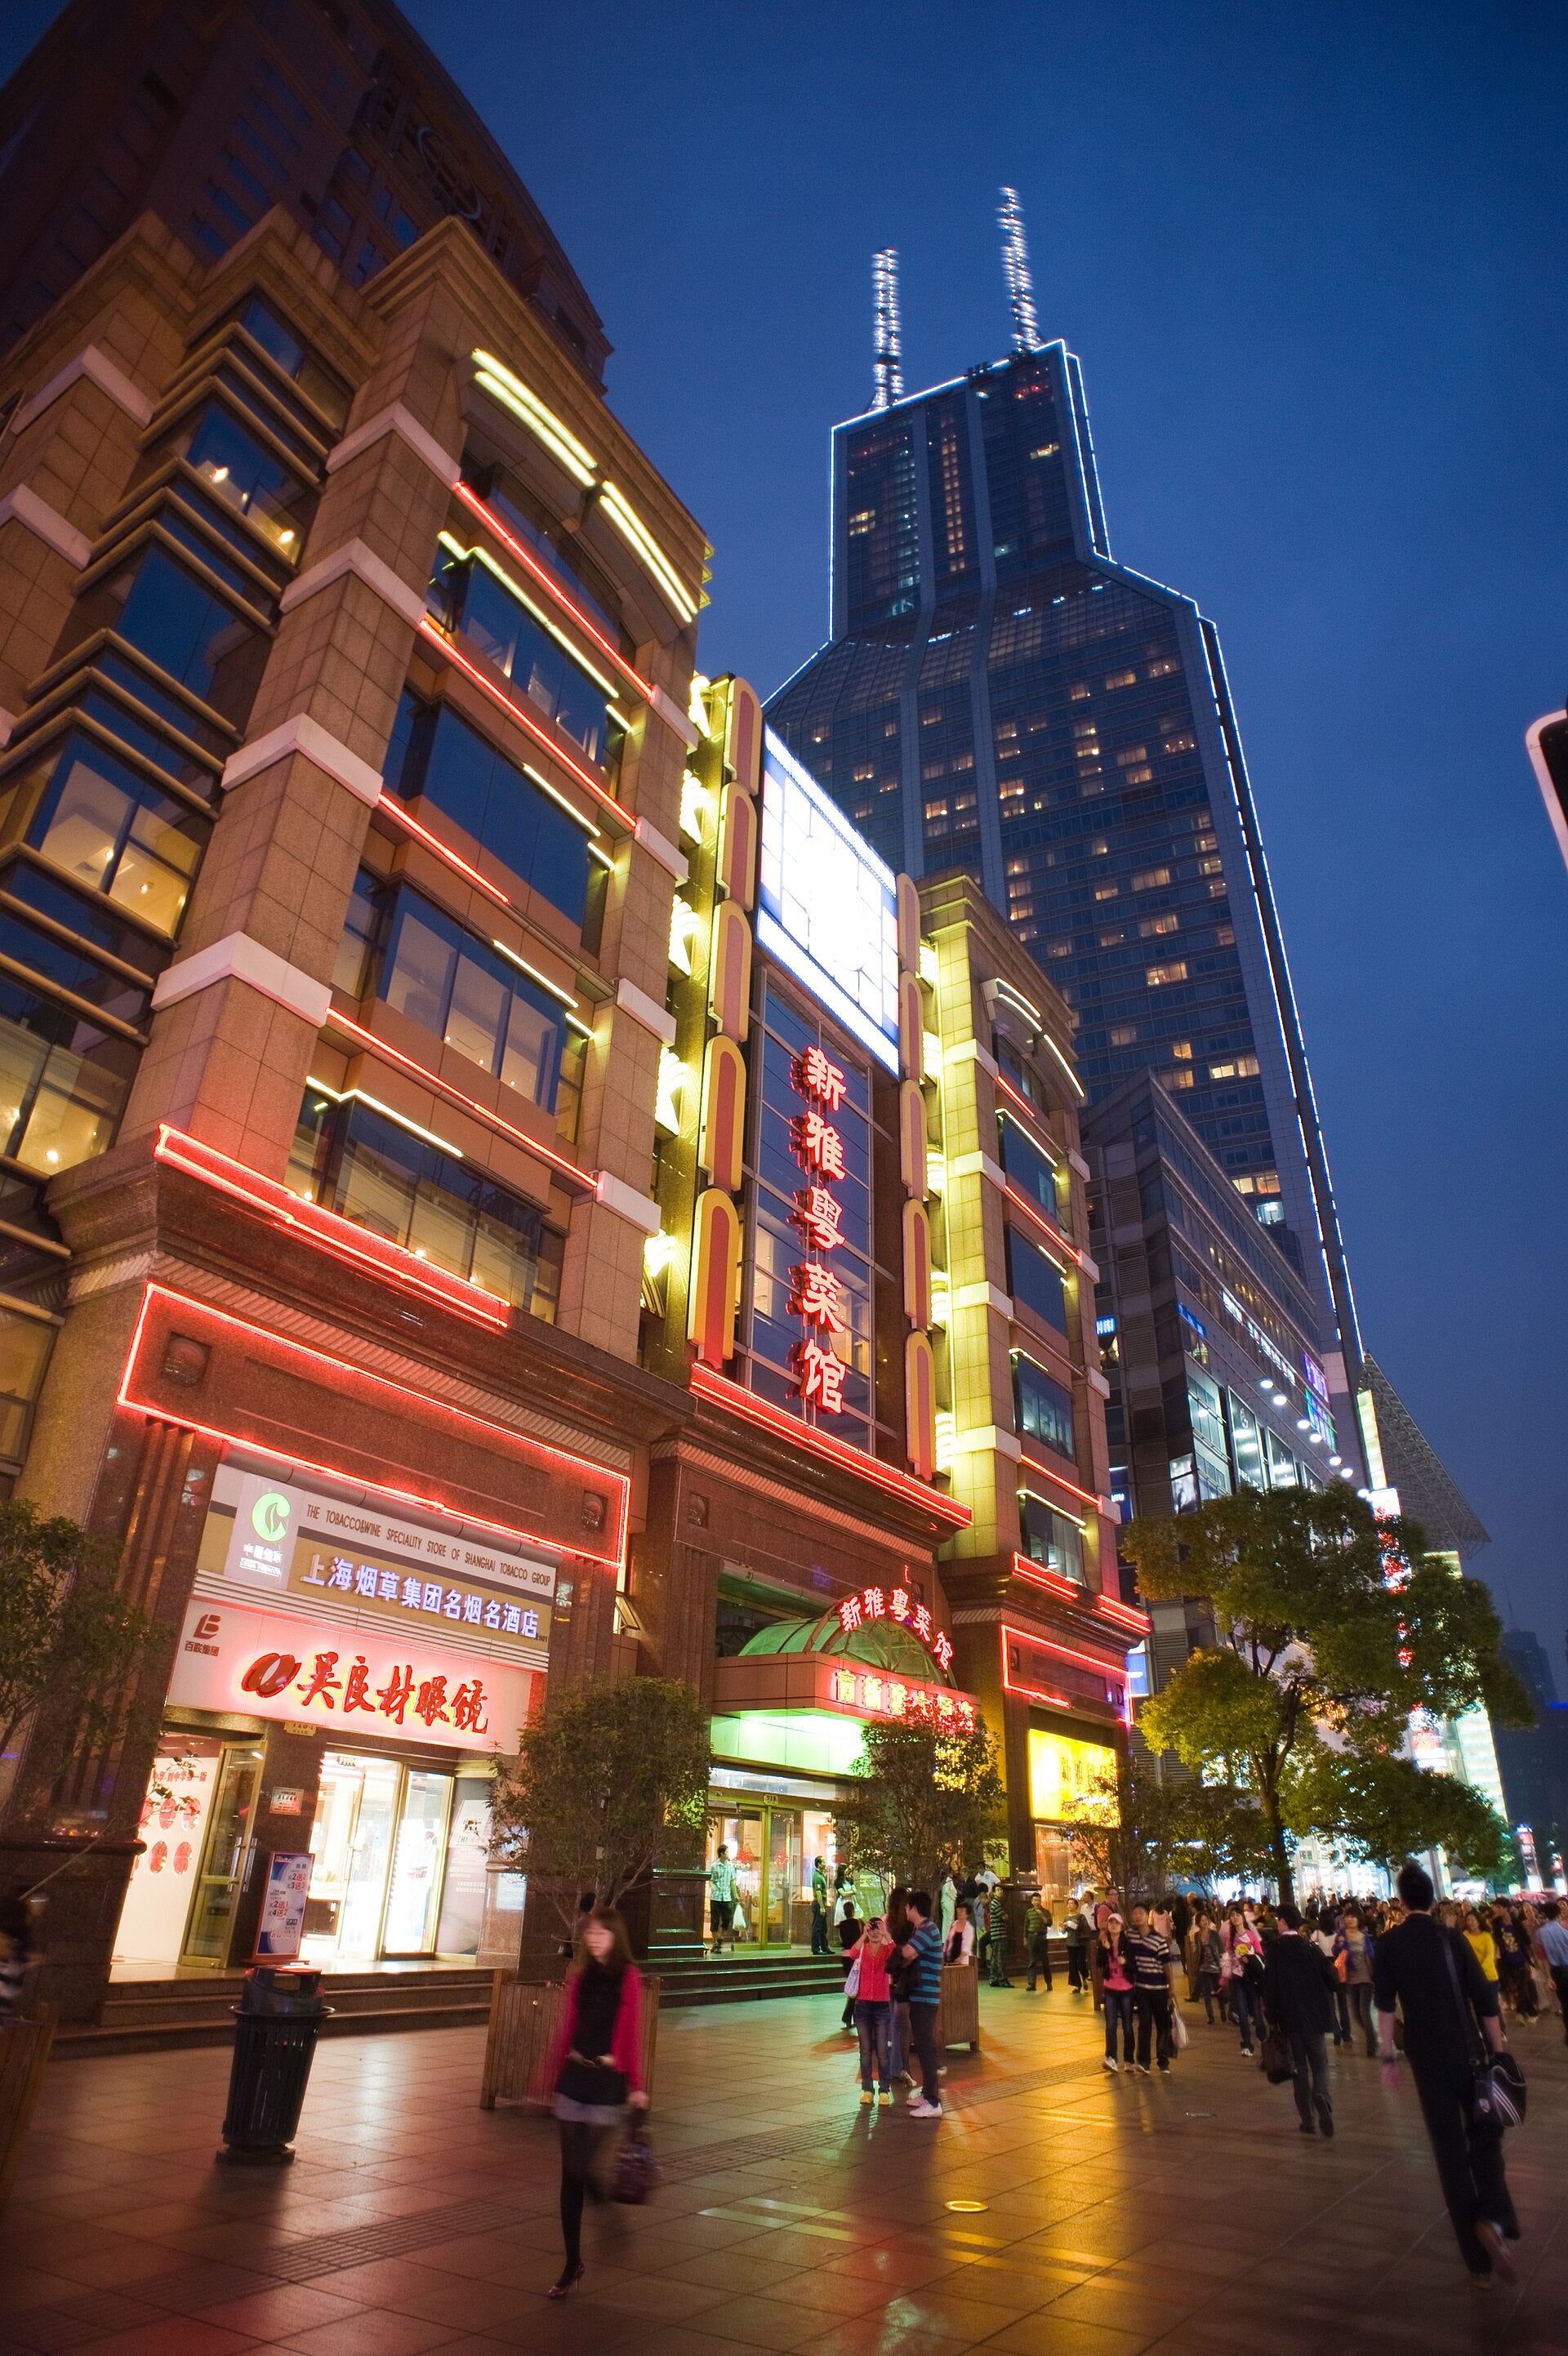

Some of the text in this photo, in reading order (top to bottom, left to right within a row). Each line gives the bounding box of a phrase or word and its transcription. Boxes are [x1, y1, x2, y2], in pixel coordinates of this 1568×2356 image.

[802, 1045, 847, 1414] 新雅粤菜馆
[306, 1504, 552, 1587] THE TOBACCO&WINE SPECIALITY STORE OF SHANGHAI TOBACCO GROUP
[300, 1553, 540, 1639] 上海烟草集团名烟名酒店
[840, 1586, 954, 1671] 新雅粤菜馆
[185, 1640, 220, 1657] 百联集团
